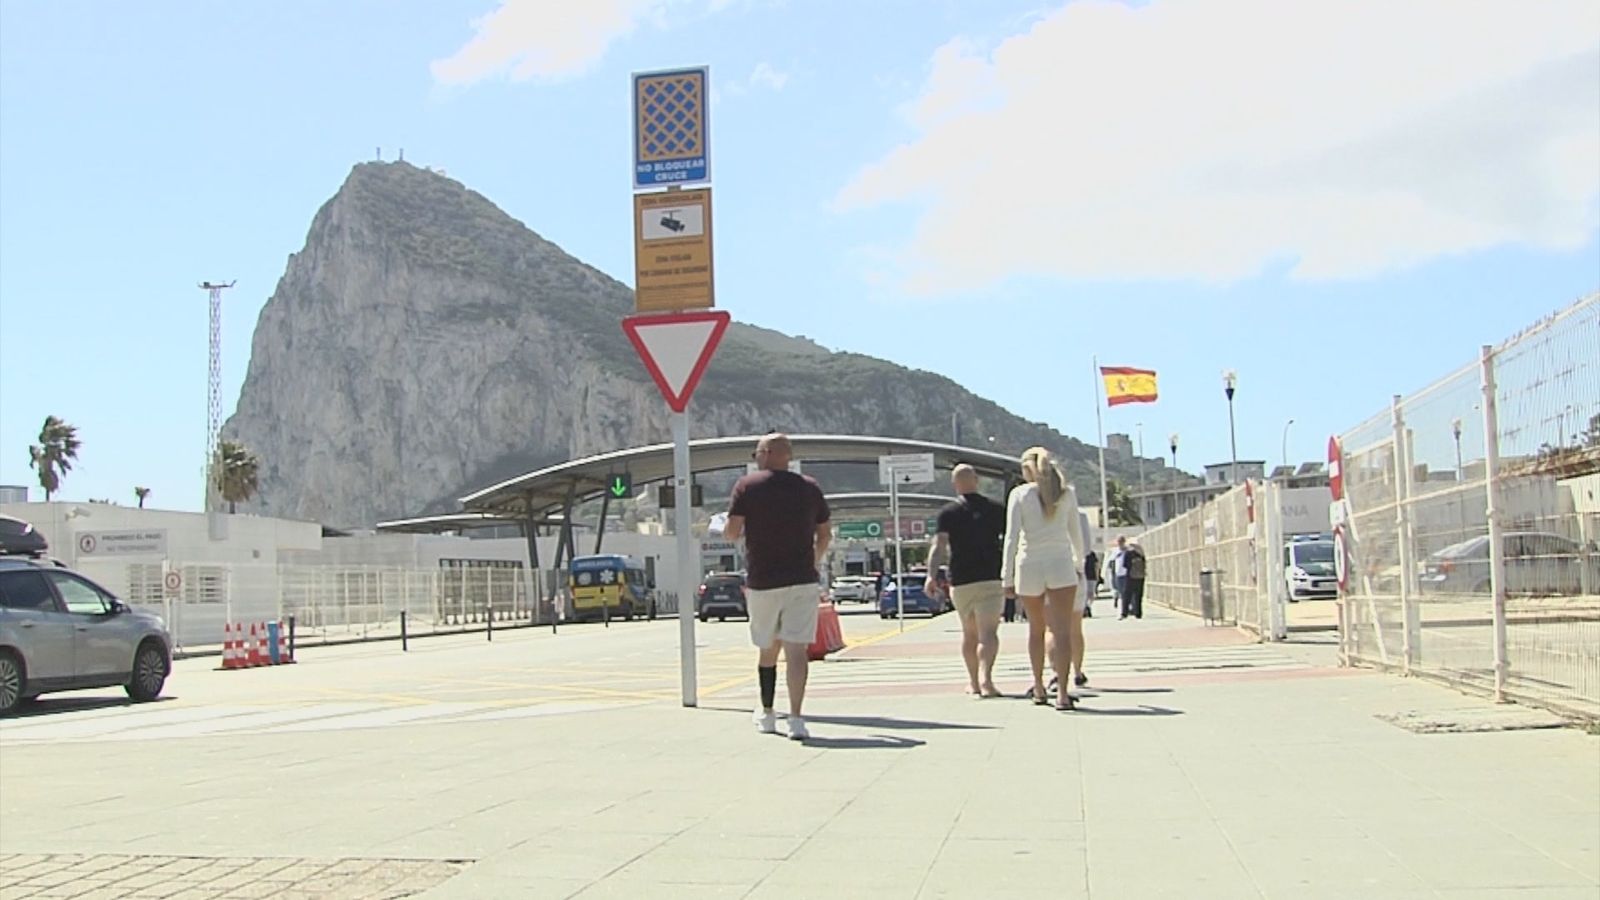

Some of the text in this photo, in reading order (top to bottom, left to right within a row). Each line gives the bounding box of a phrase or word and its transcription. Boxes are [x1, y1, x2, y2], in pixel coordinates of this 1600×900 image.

[637, 158, 704, 172] NO BLOQUEAR
[655, 170, 687, 181] CRUCE
[1281, 506, 1310, 518] ANA
